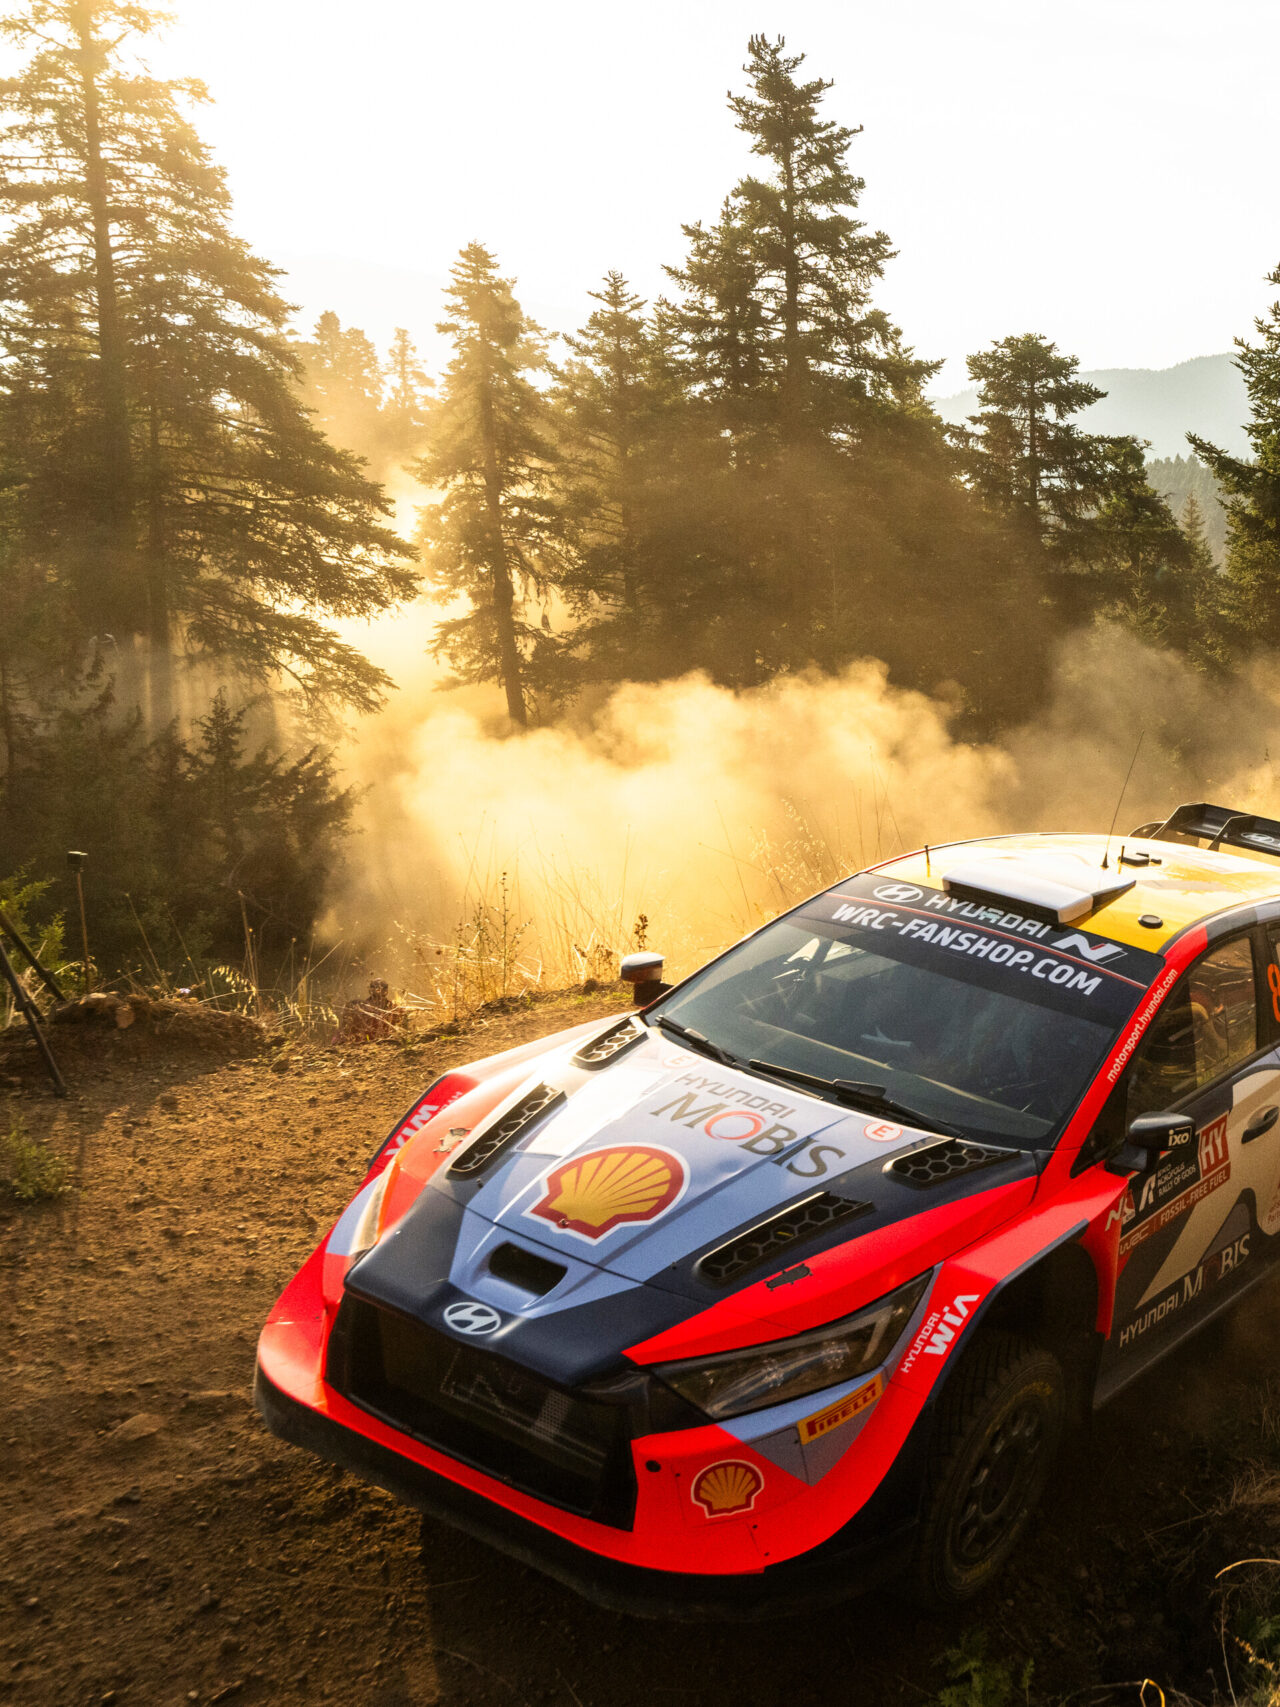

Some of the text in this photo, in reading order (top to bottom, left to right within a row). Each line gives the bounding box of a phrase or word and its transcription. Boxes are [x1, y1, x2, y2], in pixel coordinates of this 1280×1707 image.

[924, 894, 1052, 938] HYUNDAI
[831, 903, 1103, 996] WRC-FANSHOP.COM
[1107, 968, 1178, 1082] motorsport.hyundai.com
[674, 1072, 798, 1119] HYUNDAI
[649, 1091, 847, 1178] MOBIS
[1200, 1121, 1226, 1170] HY
[1160, 1182, 1209, 1226] FOSSIL-FREE
[1208, 1169, 1229, 1192] FUEL
[900, 1312, 941, 1373] HYUNDAI
[1120, 1291, 1179, 1348] HYUNDAI
[806, 1382, 877, 1438] PIRELLI
